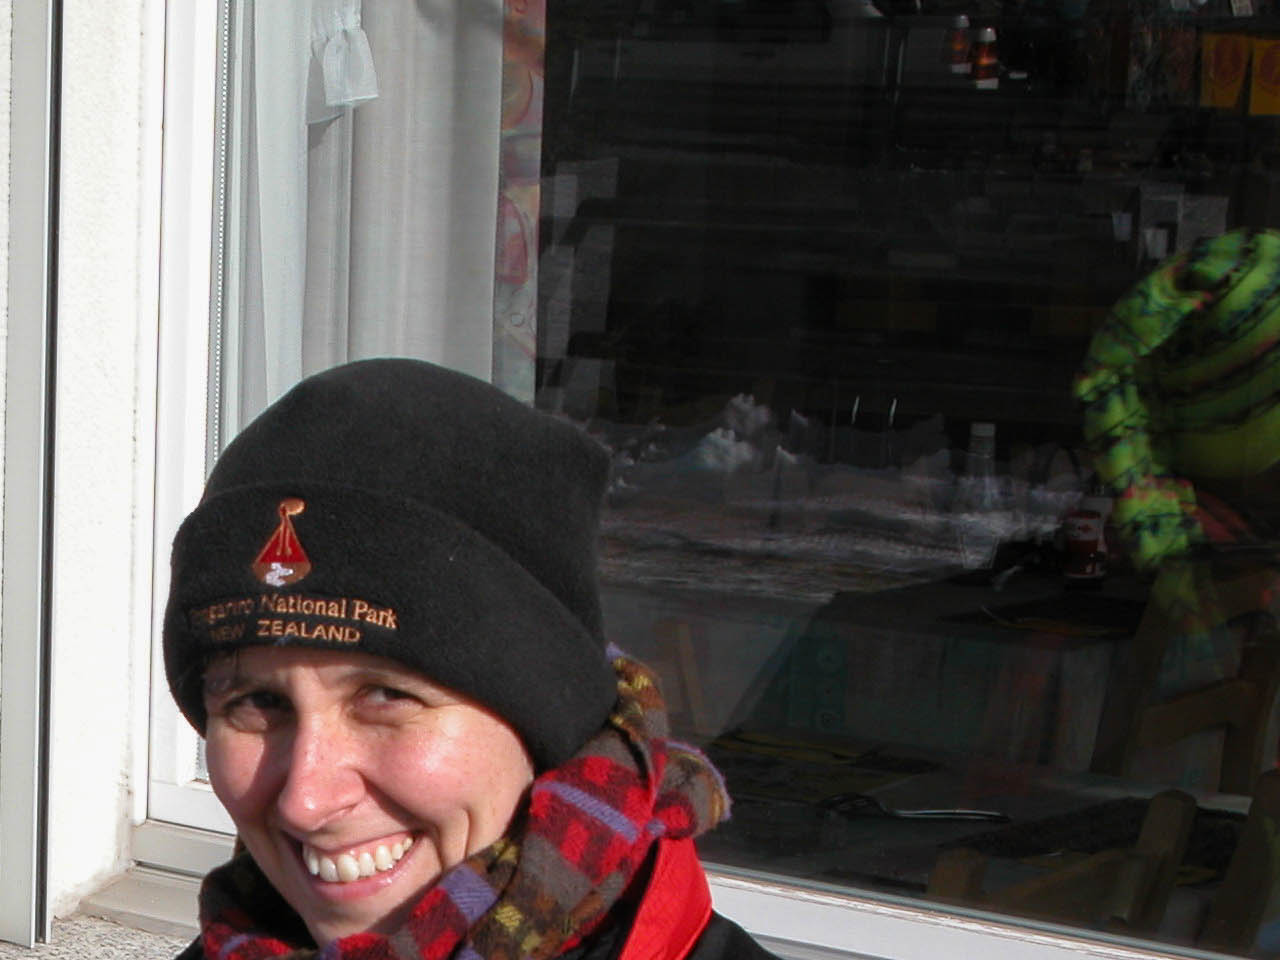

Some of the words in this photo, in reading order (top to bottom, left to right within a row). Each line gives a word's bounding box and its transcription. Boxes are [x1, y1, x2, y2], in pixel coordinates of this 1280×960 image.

[261, 593, 346, 618] National
[353, 600, 398, 629] Park
[256, 620, 361, 643] ZEALAND
